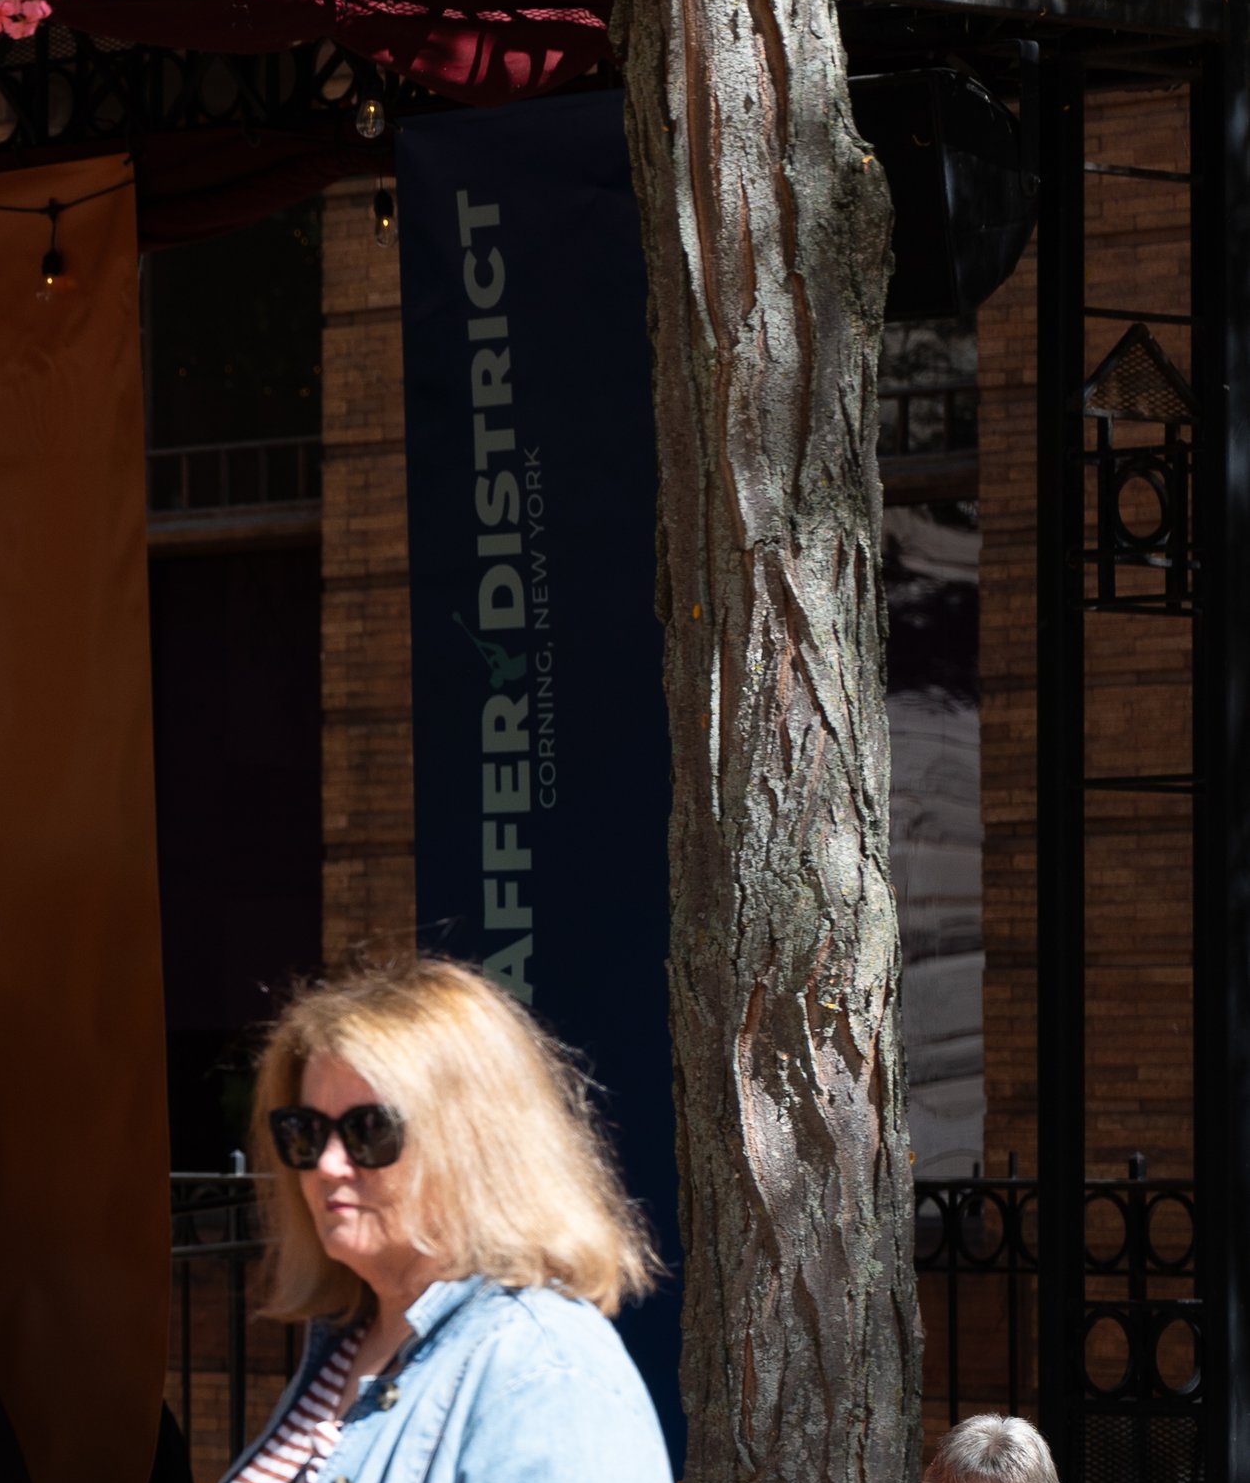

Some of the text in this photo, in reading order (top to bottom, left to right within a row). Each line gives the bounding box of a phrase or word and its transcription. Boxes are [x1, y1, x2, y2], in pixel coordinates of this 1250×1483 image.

[456, 189, 534, 1007] AFFER DISTRICT
[522, 445, 557, 810] CORNING, NEW YORK
